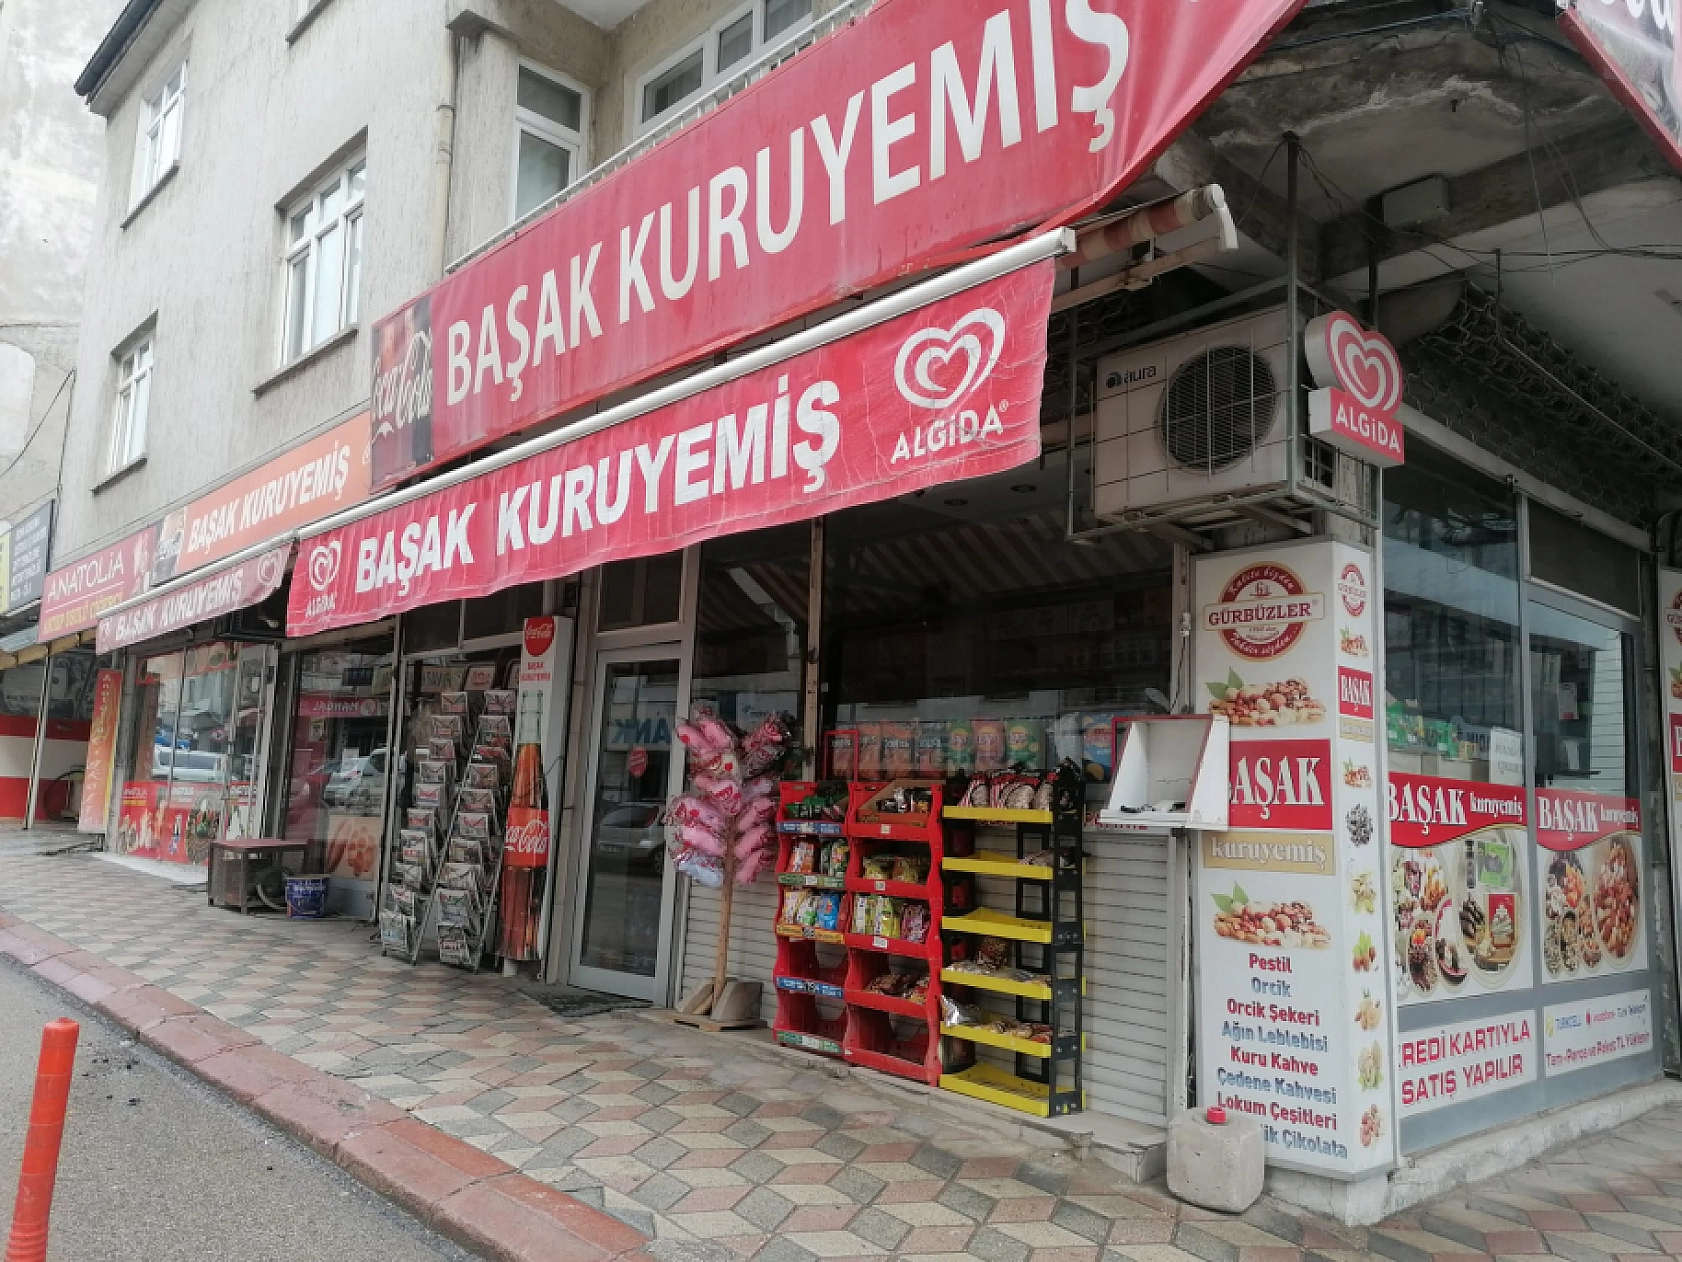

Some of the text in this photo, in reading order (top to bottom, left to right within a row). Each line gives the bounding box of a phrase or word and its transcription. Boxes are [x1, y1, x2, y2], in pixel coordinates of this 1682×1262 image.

[445, 241, 602, 405] BAŞAK
[187, 440, 350, 554] BAŞAK KURUYEMİŞ
[355, 375, 840, 597] BAŞAK KURUYEMİŞ
[115, 604, 158, 641] BAŞAK
[1209, 602, 1312, 626] GÜRBÜZLER
[1341, 674, 1371, 712] BAŞAK
[1229, 755, 1325, 820] AŞAK
[1388, 781, 1523, 834] BAŞAK kuruyemiş
[1538, 796, 1600, 842] BAŞAK
[1211, 837, 1326, 870] kuruyemiş
[1249, 952, 1292, 973] Pestil
[1251, 976, 1292, 997] Orcik
[1227, 998, 1320, 1027] Orcik Şekeri
[1222, 1021, 1328, 1052] Ağın Leblebisi
[1399, 1019, 1531, 1067] REDİ KARTIYLA
[1230, 1045, 1319, 1076] Kuru Kahve
[1401, 1053, 1523, 1106] SATIŞ YAPILIR
[1217, 1066, 1337, 1104] Çedene Kahvesi
[1217, 1091, 1337, 1130] Lokum Çeşitleri
[1282, 1128, 1348, 1159] Çikolata
